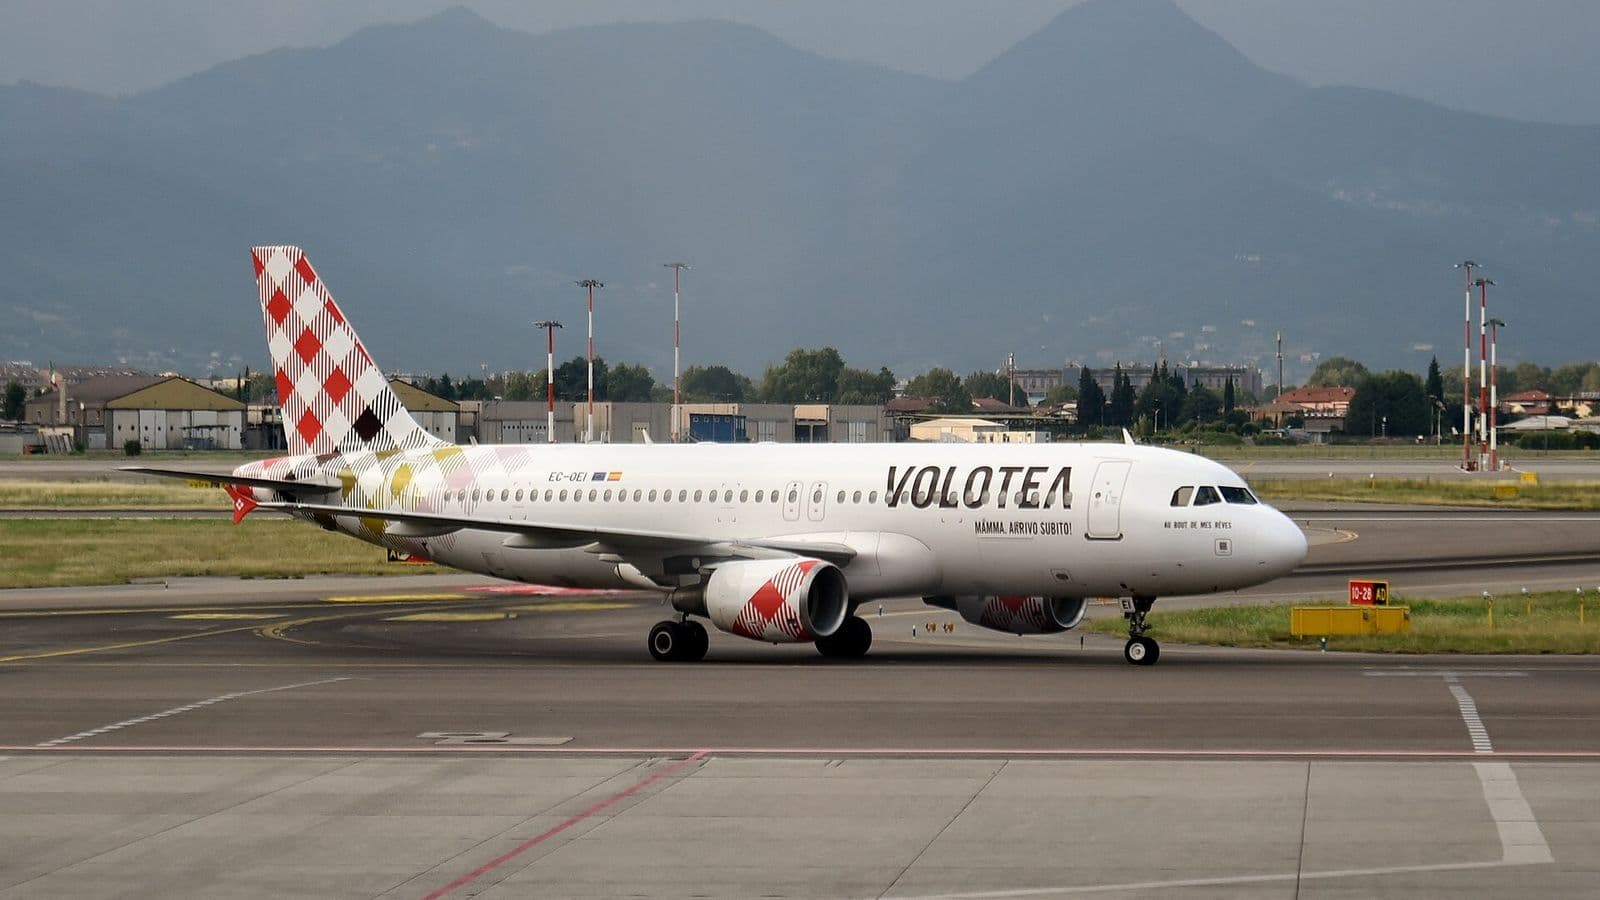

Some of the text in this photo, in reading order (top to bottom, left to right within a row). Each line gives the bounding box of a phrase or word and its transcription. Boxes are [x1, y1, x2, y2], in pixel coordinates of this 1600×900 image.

[548, 471, 588, 482] EC-OEI
[887, 465, 1073, 510] VOLOTEA
[1009, 521, 1038, 535] ARRIVO
[1040, 522, 1073, 536] SUBITO!
[1351, 586, 1373, 601] 10-28
[1121, 600, 1132, 610] EI
